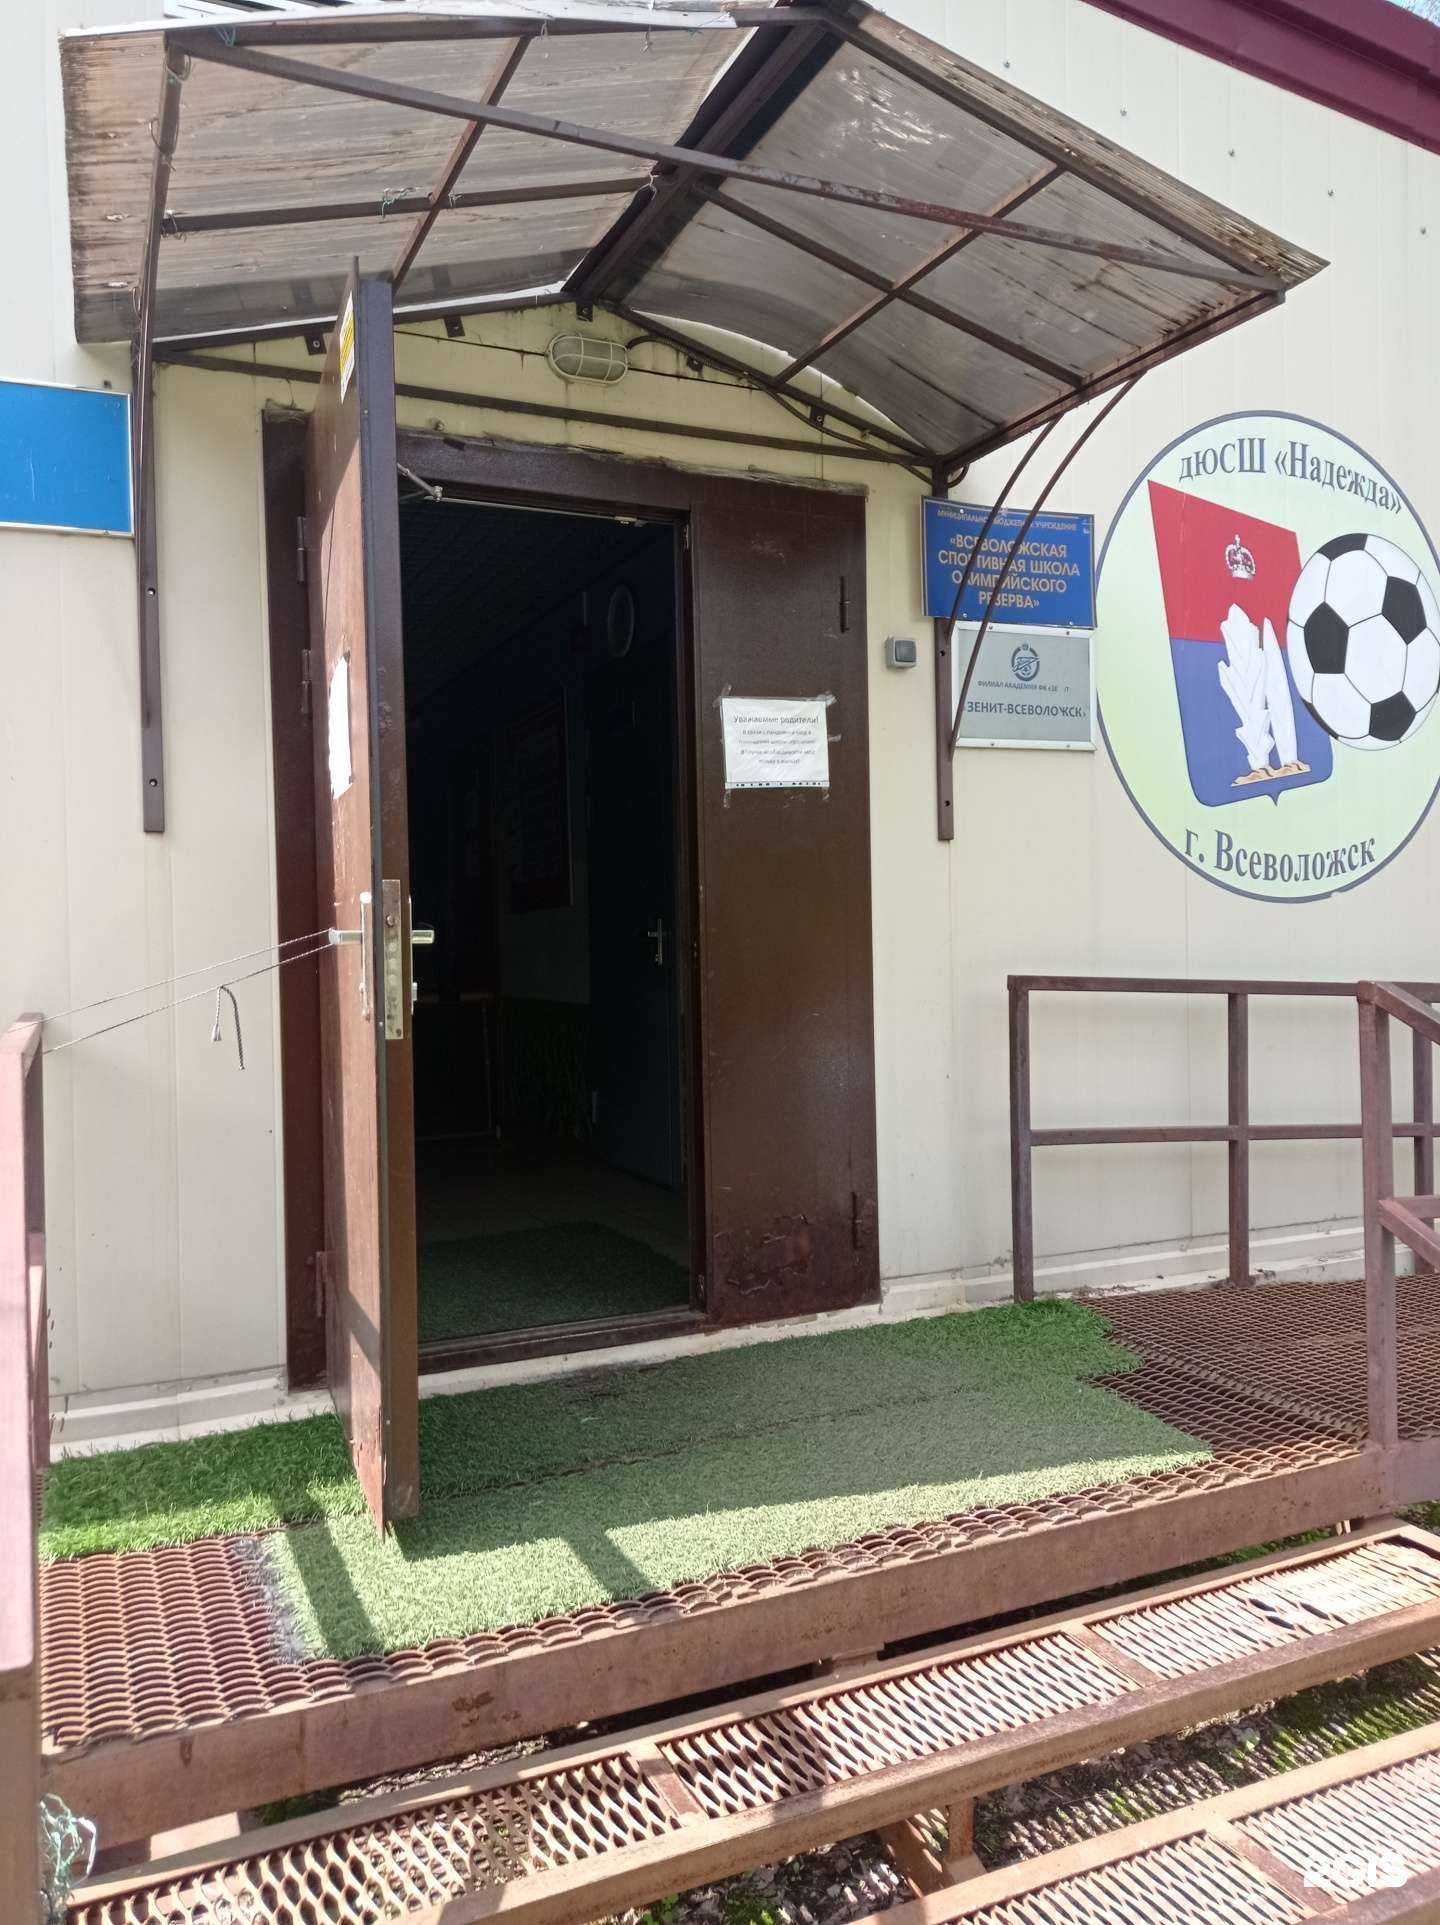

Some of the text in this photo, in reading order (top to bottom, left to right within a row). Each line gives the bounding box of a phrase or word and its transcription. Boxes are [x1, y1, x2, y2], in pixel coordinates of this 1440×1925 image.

[1274, 440, 1402, 514] «Надежда»
[938, 550, 1080, 576] СПОТИВНАЯ ШКОЛА
[1185, 828, 1376, 883] г. Всеволожск
